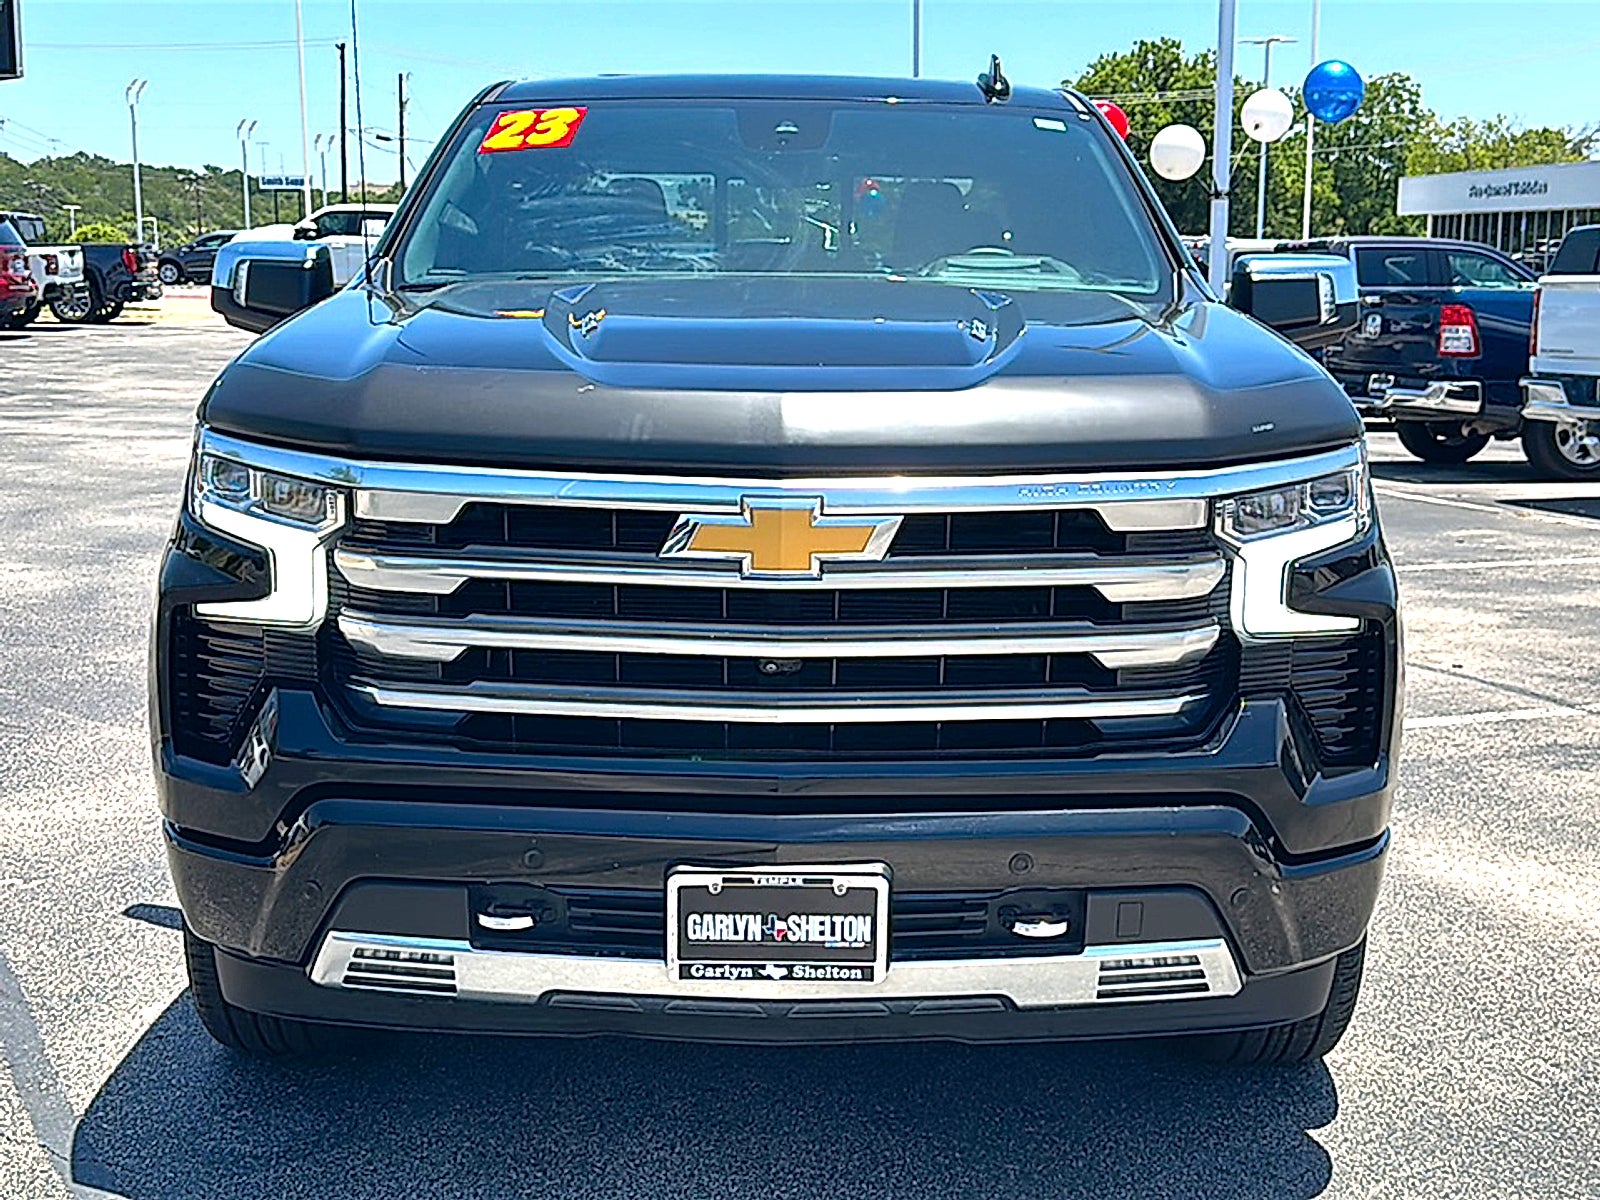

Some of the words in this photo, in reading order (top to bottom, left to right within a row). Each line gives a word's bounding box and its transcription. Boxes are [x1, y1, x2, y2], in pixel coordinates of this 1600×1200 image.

[483, 108, 580, 149] 23
[687, 913, 762, 942] GARLYN
[787, 915, 871, 942] SHELTON
[690, 964, 754, 980] Garlyn
[792, 965, 863, 980] Shelton
